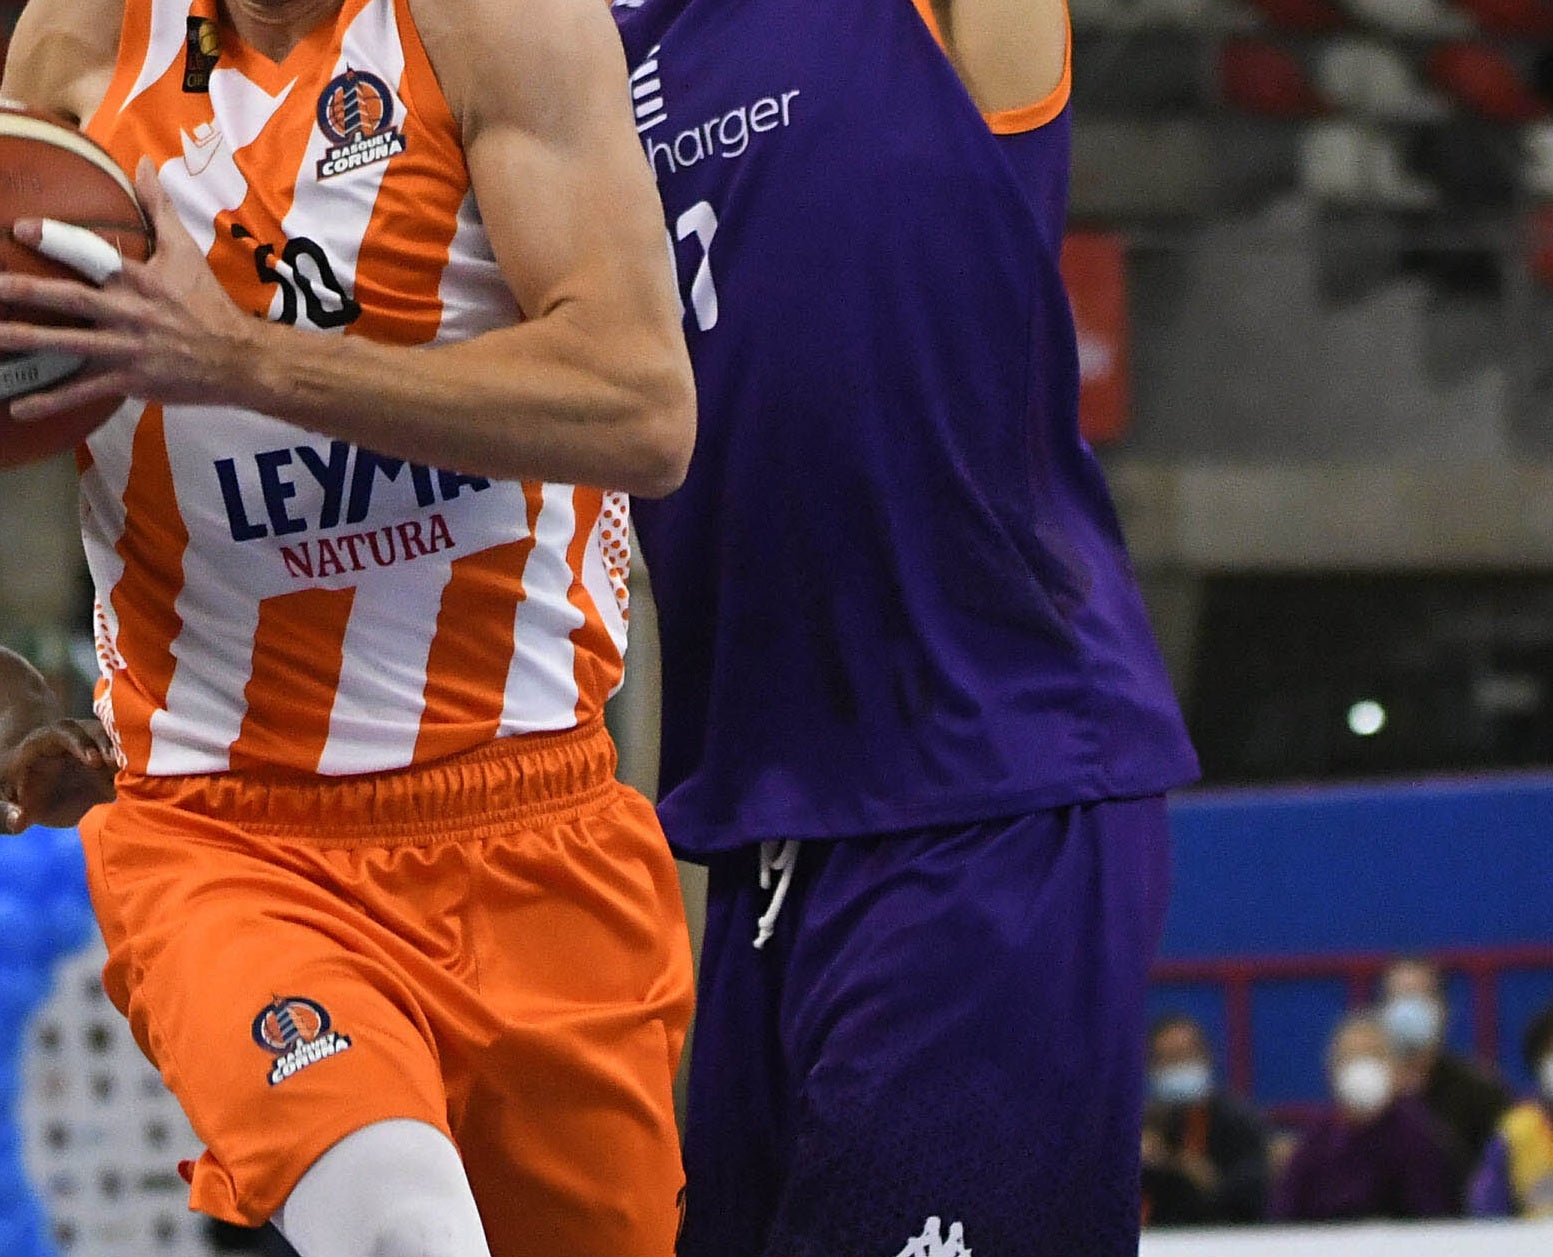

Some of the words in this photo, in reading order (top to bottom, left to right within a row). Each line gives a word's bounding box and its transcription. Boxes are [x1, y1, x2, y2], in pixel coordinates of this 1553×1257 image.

[646, 90, 801, 175] harger
[665, 201, 719, 332] 7
[279, 514, 456, 579] NATURA
